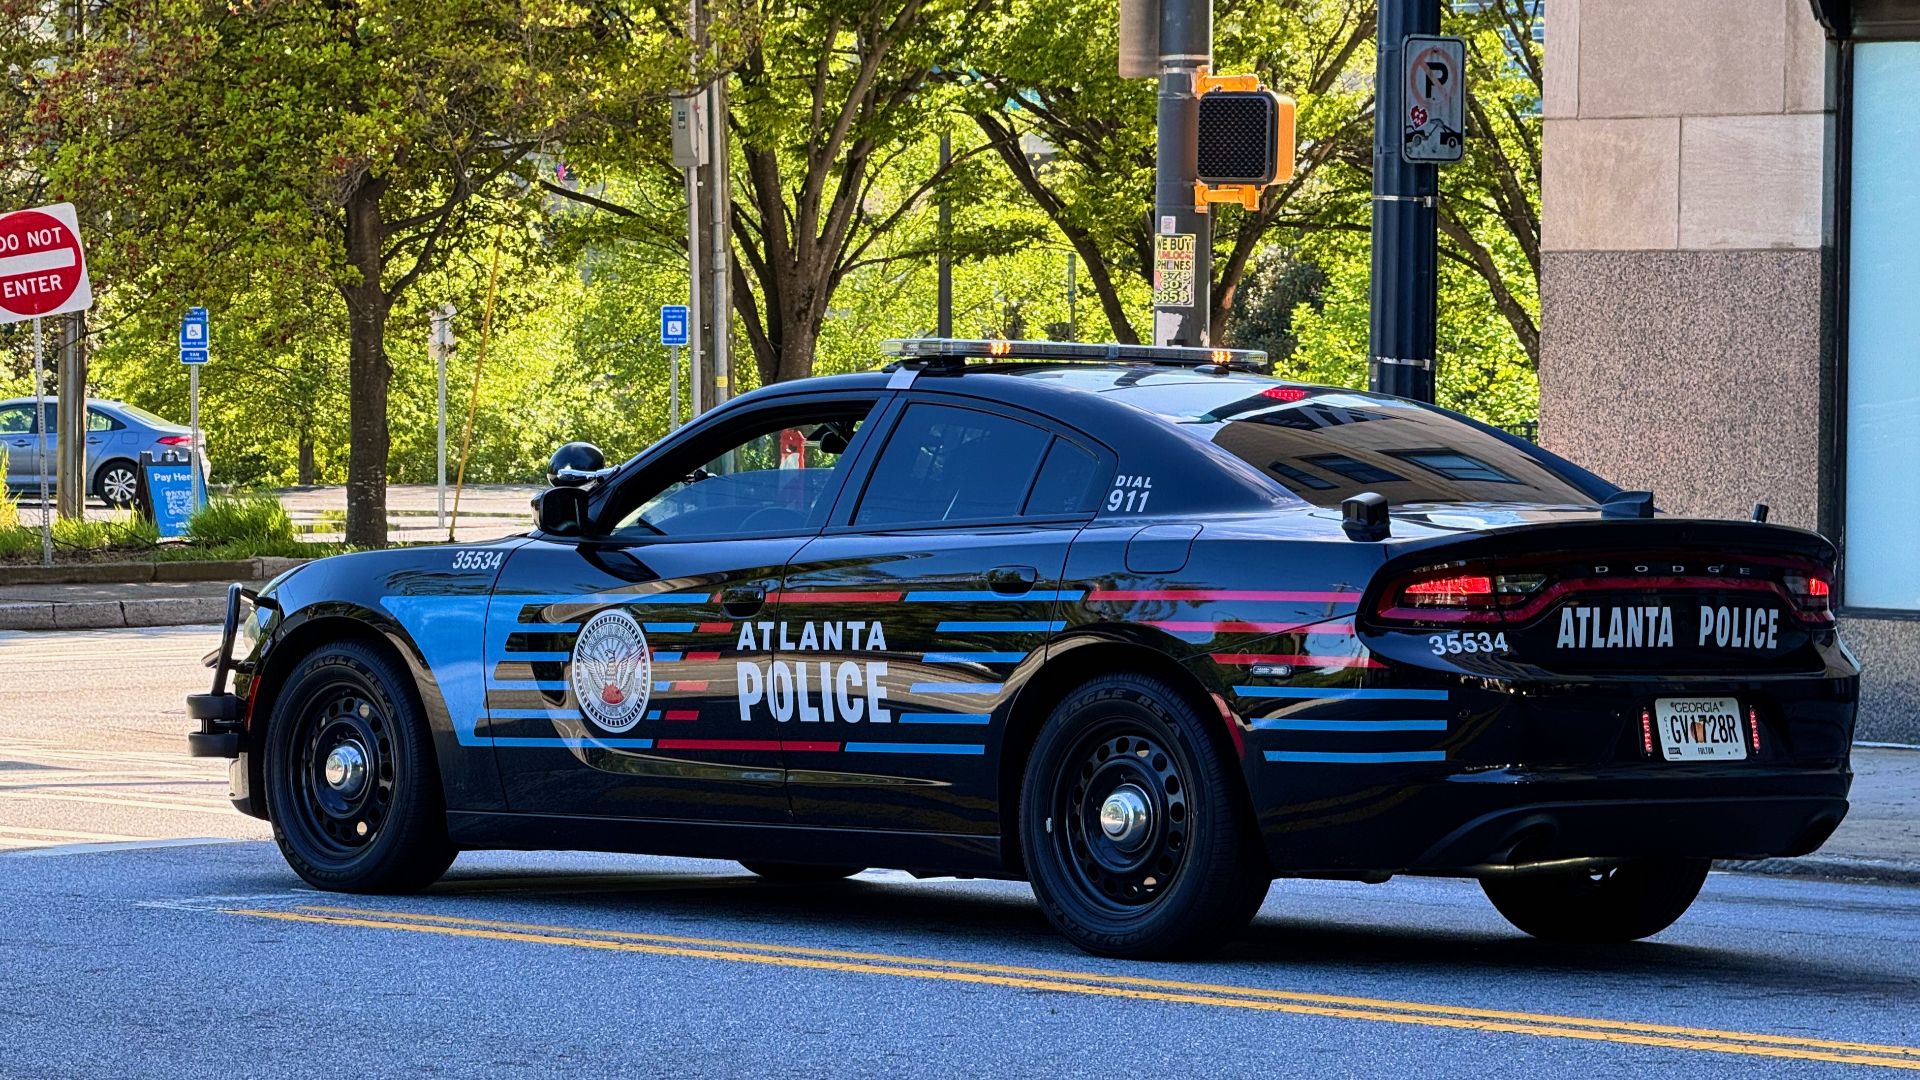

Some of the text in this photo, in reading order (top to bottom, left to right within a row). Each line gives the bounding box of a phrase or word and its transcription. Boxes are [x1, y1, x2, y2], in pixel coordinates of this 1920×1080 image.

[27, 227, 62, 248] NOT
[3, 274, 63, 298] ENTER
[153, 472, 192, 483] Pay Her
[1115, 475, 1153, 488] DIAL
[1107, 489, 1149, 513] 911
[451, 550, 504, 571] 35534
[1594, 564, 1751, 575] DODGE
[736, 621, 888, 651] ATLANTA
[1556, 605, 1779, 649] ATLANTA POLICE
[1428, 632, 1509, 656] 35534
[735, 661, 892, 724] POLICE
[1057, 688, 1127, 725] EAGLE
[1674, 702, 1720, 713] GEORGIA
[1670, 714, 1739, 744] GV1728R
